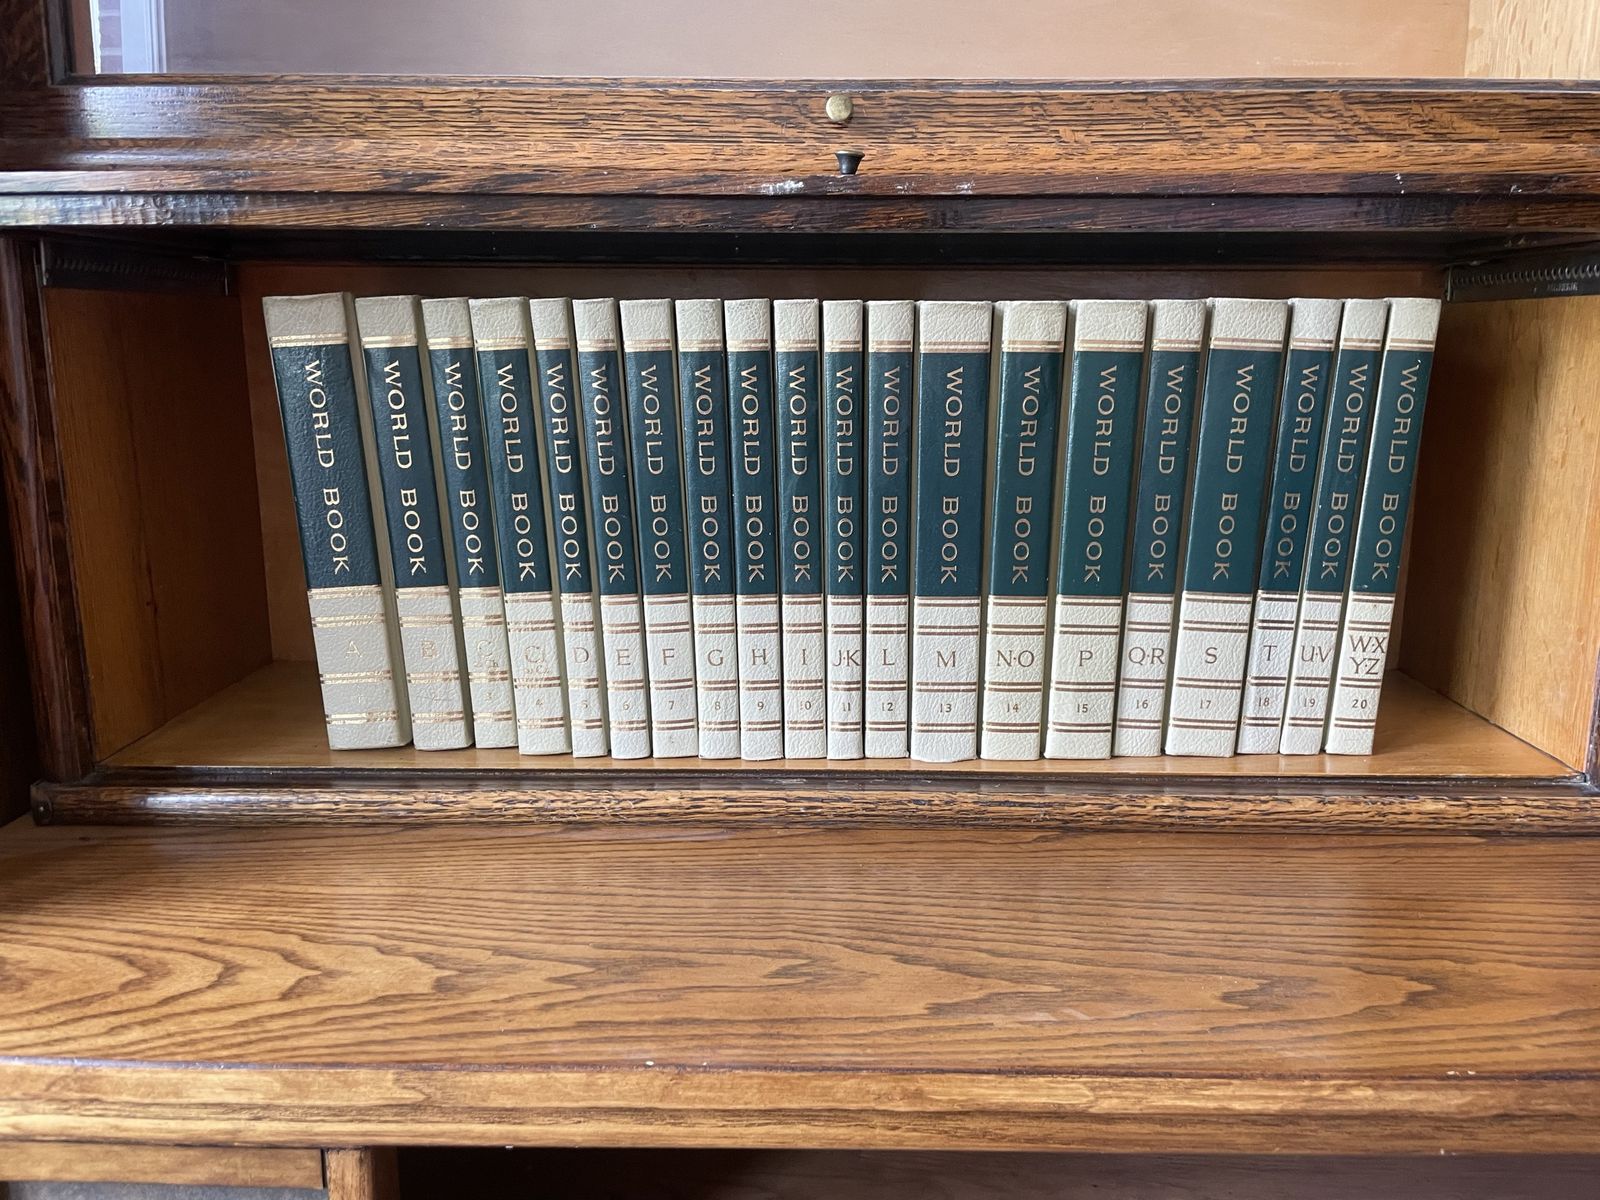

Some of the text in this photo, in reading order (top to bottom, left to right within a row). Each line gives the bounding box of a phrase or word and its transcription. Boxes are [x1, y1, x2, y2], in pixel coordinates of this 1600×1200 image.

[304, 359, 350, 575] WORLD BOOK
[383, 359, 427, 576] WORLD BOOK
[444, 361, 485, 576] WORLD BOOK
[497, 363, 536, 582] WORLD BOOK
[546, 363, 582, 581] WORLD BOOK
[589, 364, 625, 584] WORLD BOOK
[640, 364, 672, 583] WORLD BOOK
[694, 364, 721, 583] WORLD BOOK
[740, 364, 765, 583] WORLD BOOK
[788, 365, 811, 583] WORLD BOOK
[835, 365, 854, 583] WORLD BOOK
[881, 366, 900, 583] WORLD BOOK
[940, 366, 964, 584] WORLD BOOK
[1012, 365, 1041, 584] WORLD BOOK
[1084, 365, 1118, 583] WORLD BOOK
[1147, 364, 1185, 581] WORLD BOOK
[1212, 364, 1254, 581] WORLD BOOK
[1273, 364, 1320, 578] WORLD BOOK
[1320, 364, 1369, 579] WORLD BOOK
[1371, 364, 1420, 580] WORLD BOOK
[344, 640, 363, 659] A
[421, 640, 438, 660] B
[573, 646, 590, 664] D
[616, 648, 632, 666] E
[661, 648, 675, 666] F
[707, 649, 724, 667] G
[751, 648, 769, 666] H
[801, 648, 807, 666] I
[881, 648, 896, 667] L
[1078, 650, 1094, 667] P
[1205, 647, 1218, 665] S
[1262, 644, 1278, 662] T
[936, 651, 957, 669] M
[668, 700, 675, 711] 7
[714, 700, 721, 711] 8
[757, 701, 764, 711] 9
[842, 702, 851, 712] 11
[881, 701, 893, 712] 12
[939, 702, 953, 713] 13
[1007, 702, 1019, 714] 14
[1077, 702, 1089, 714] 15
[1135, 699, 1149, 710] 16
[1199, 699, 1212, 710] 17
[1258, 696, 1270, 708] 18
[1303, 697, 1317, 709] 19
[1352, 698, 1368, 710] 20
